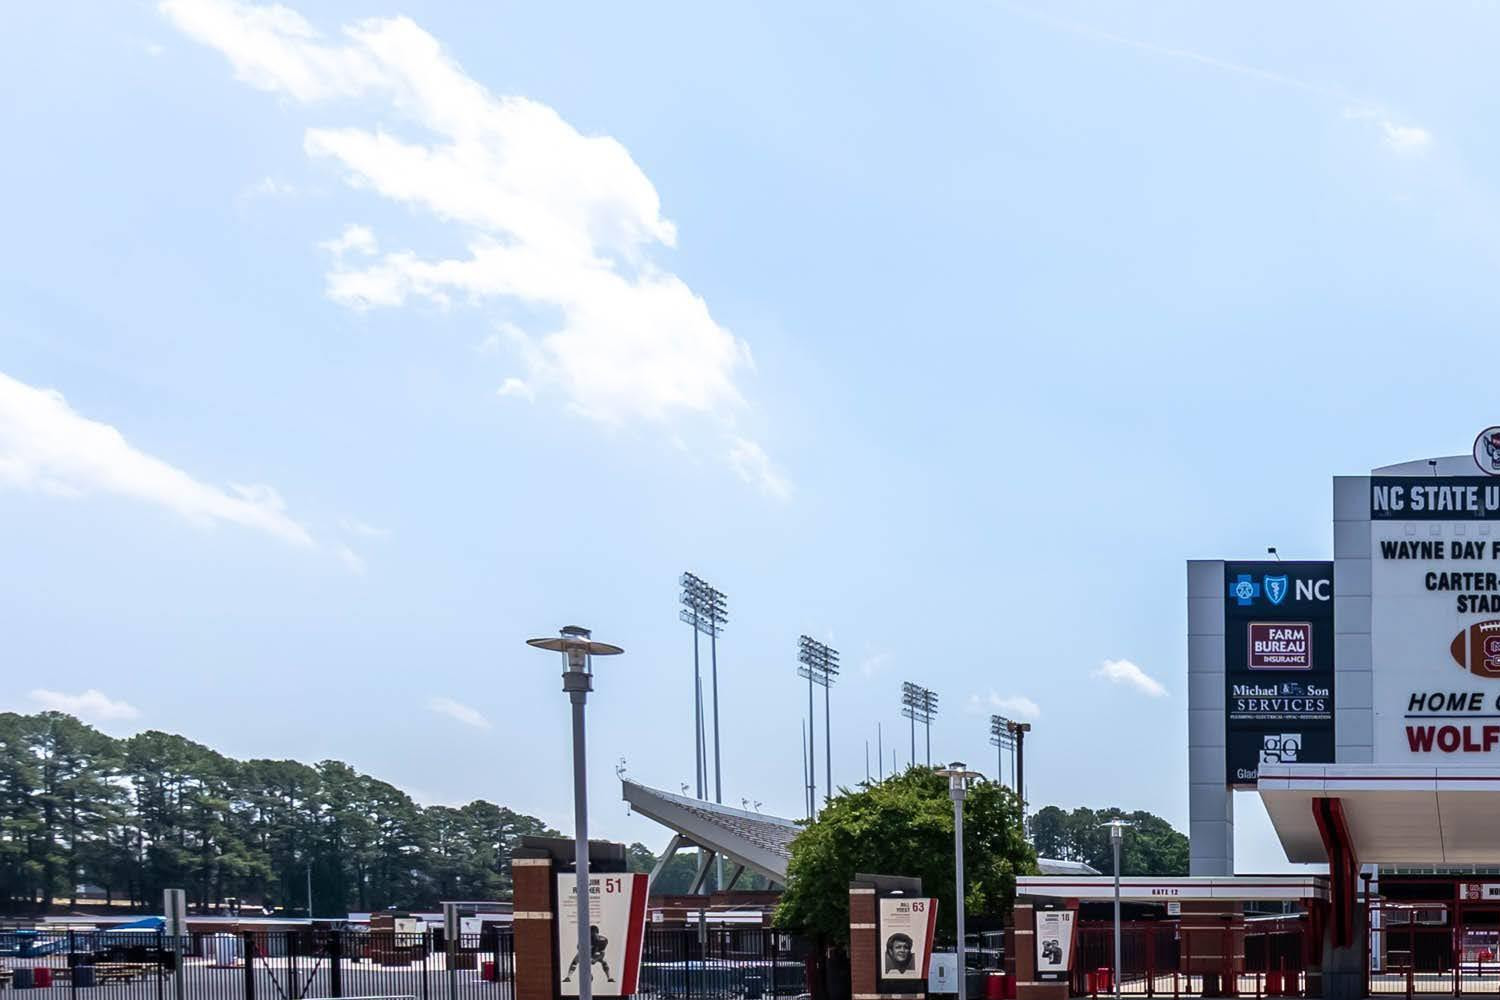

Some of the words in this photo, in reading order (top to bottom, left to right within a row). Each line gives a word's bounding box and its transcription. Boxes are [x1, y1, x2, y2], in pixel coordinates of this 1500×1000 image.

[1373, 486, 1404, 512] NC
[1410, 486, 1478, 511] STATE
[1381, 542, 1446, 560] WAYNE
[1451, 542, 1485, 560] DAY
[1296, 579, 1330, 600] NC
[1269, 629, 1304, 640] FARM
[1255, 641, 1305, 652] BUREAU
[1233, 685, 1277, 695] Michael
[1308, 685, 1328, 695] Son
[1238, 700, 1325, 710] SERVICES
[1408, 694, 1484, 710] HOME
[1237, 769, 1257, 778] Glad
[606, 879, 621, 893] 51
[913, 903, 924, 912] 63
